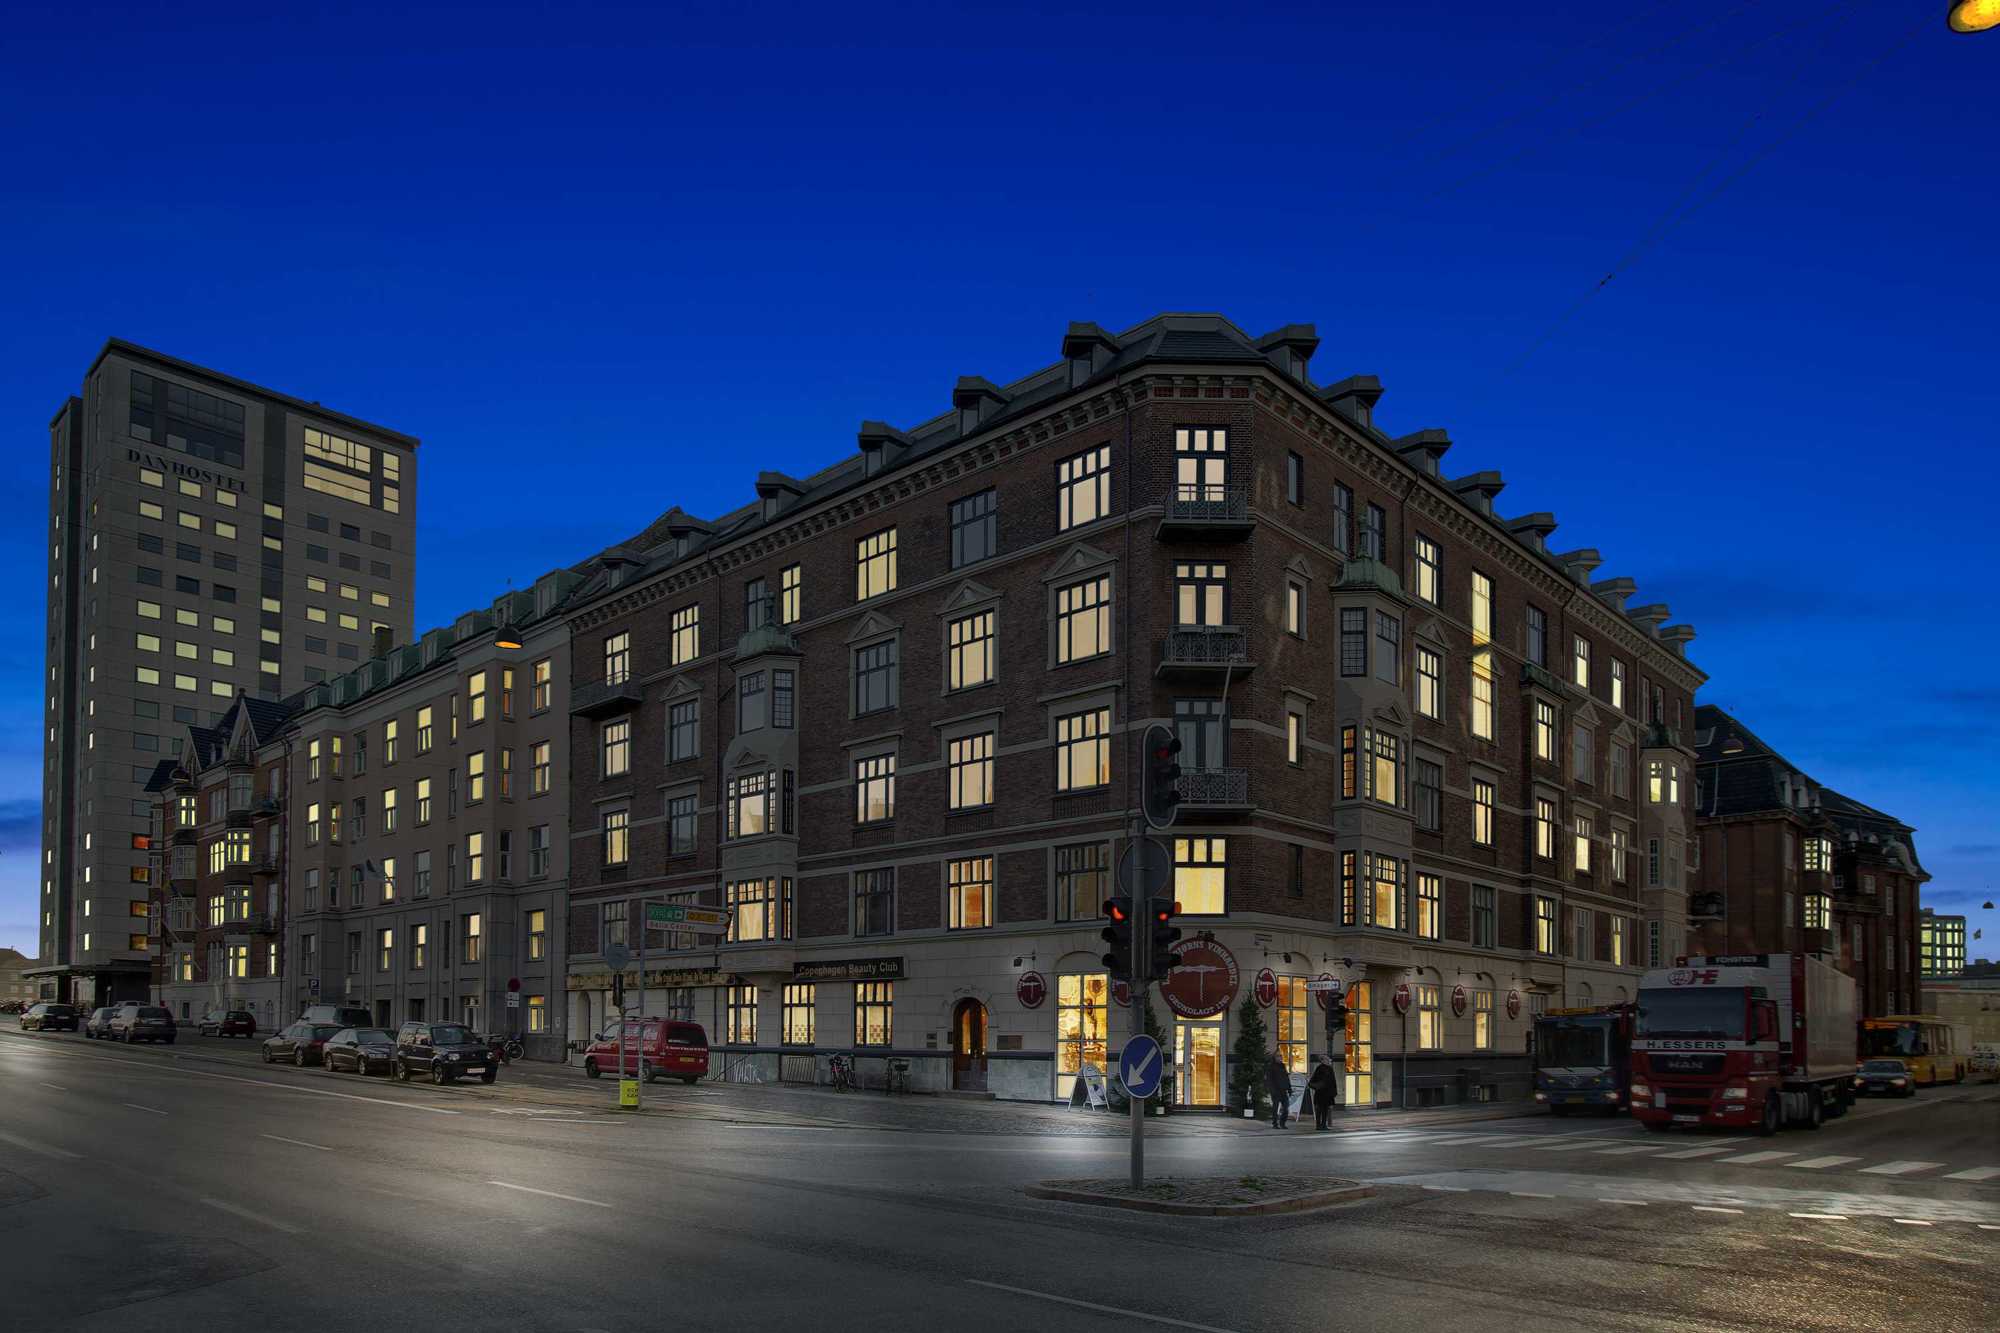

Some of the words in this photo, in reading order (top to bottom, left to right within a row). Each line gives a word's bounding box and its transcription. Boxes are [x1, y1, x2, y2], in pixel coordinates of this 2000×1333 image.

[128, 449, 247, 492] DANHOSTEL
[799, 965, 847, 977] Copenhagen
[848, 963, 876, 977] Beauty
[880, 960, 899, 972] Club
[1647, 1040, 1727, 1050] H.ESSERS
